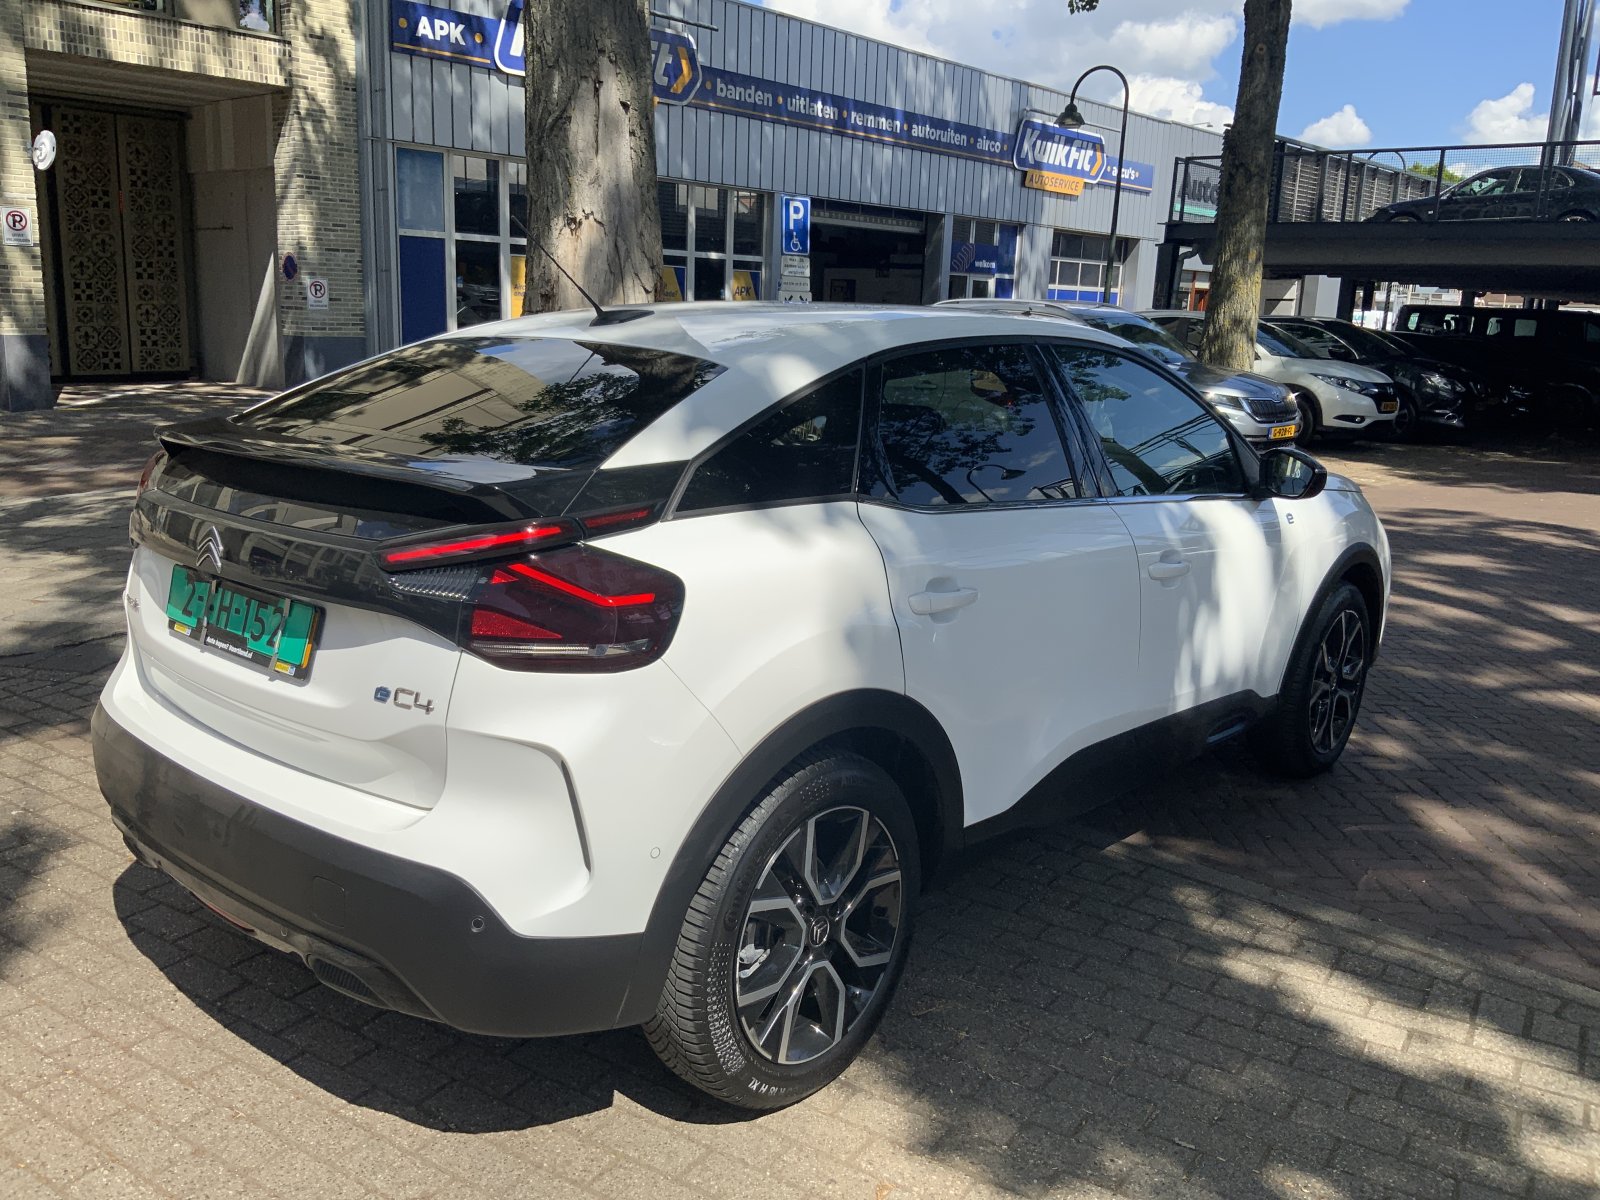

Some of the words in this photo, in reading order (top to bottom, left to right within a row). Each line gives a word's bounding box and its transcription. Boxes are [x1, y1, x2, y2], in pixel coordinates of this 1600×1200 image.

[415, 15, 467, 46] APK
[716, 78, 773, 108] banden
[787, 94, 839, 121] uitlaten
[850, 110, 901, 133] remmen
[911, 121, 967, 147] autoruiten
[976, 137, 1001, 153] airco
[1028, 172, 1080, 192] AUTOSERVICE
[1111, 166, 1136, 181] acu's
[789, 200, 804, 230] P
[975, 260, 996, 269] welkom
[735, 286, 752, 297] APK
